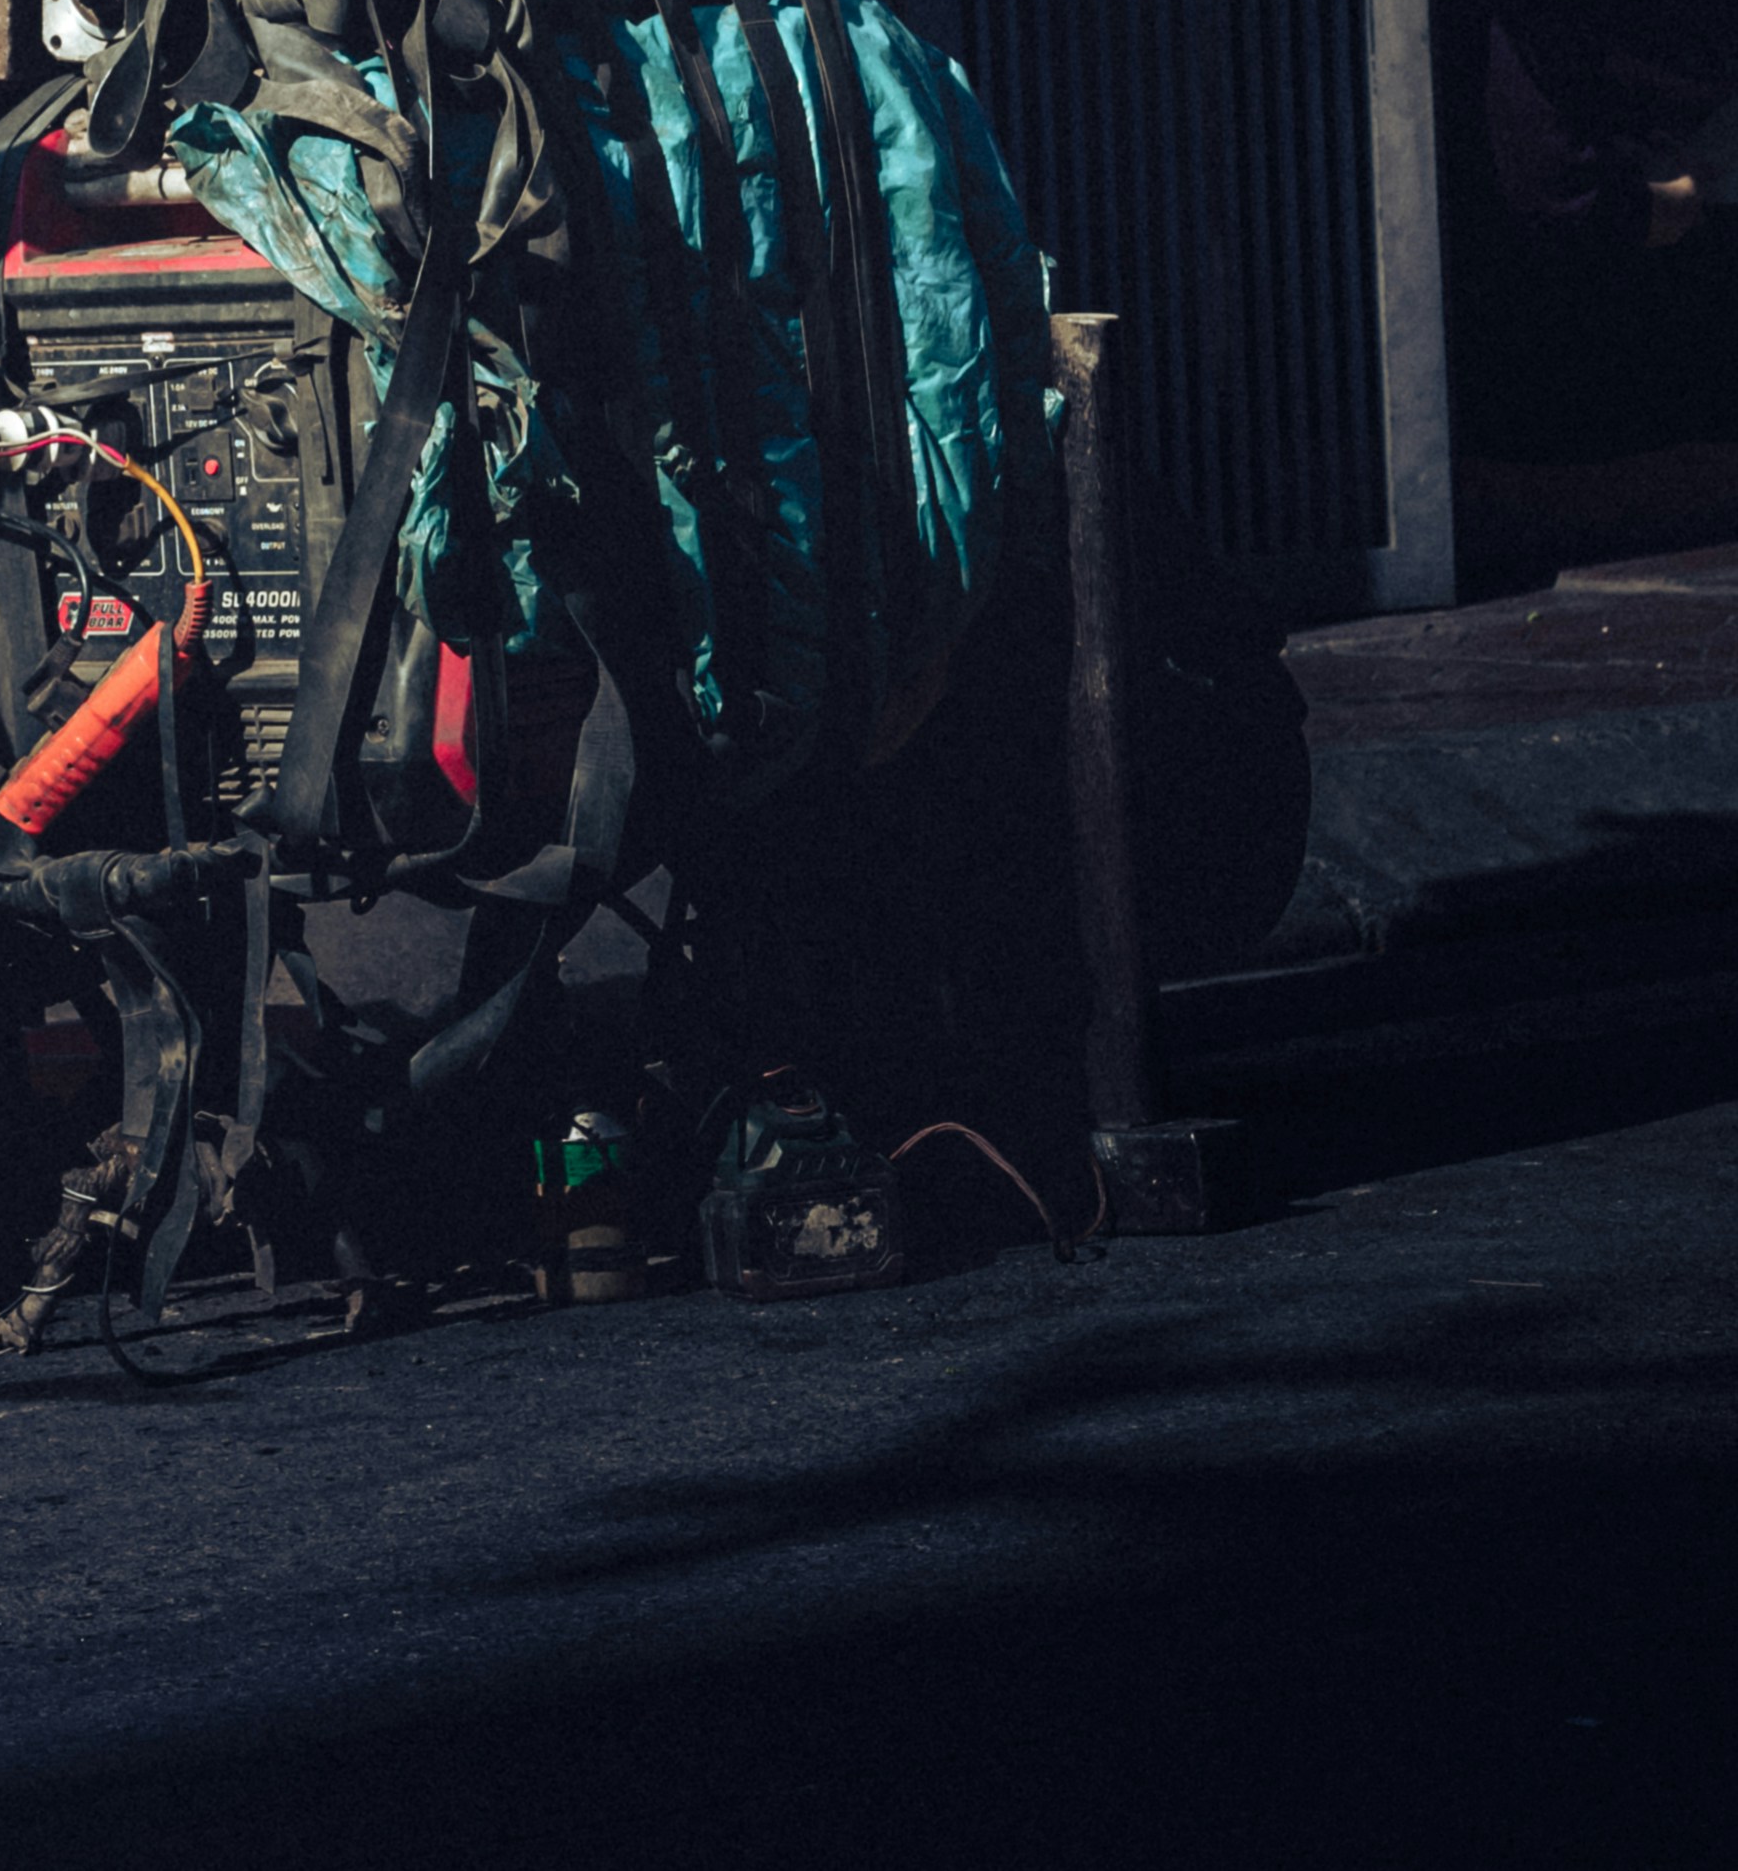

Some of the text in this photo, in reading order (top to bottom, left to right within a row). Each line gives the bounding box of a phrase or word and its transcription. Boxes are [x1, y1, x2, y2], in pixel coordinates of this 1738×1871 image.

[191, 507, 225, 516] ECONOMY
[251, 522, 286, 531] OVERLOAD
[260, 541, 286, 550] OUTPUT
[92, 603, 124, 615] FULL
[88, 617, 125, 628] BOAR
[252, 615, 277, 625] MAX.
